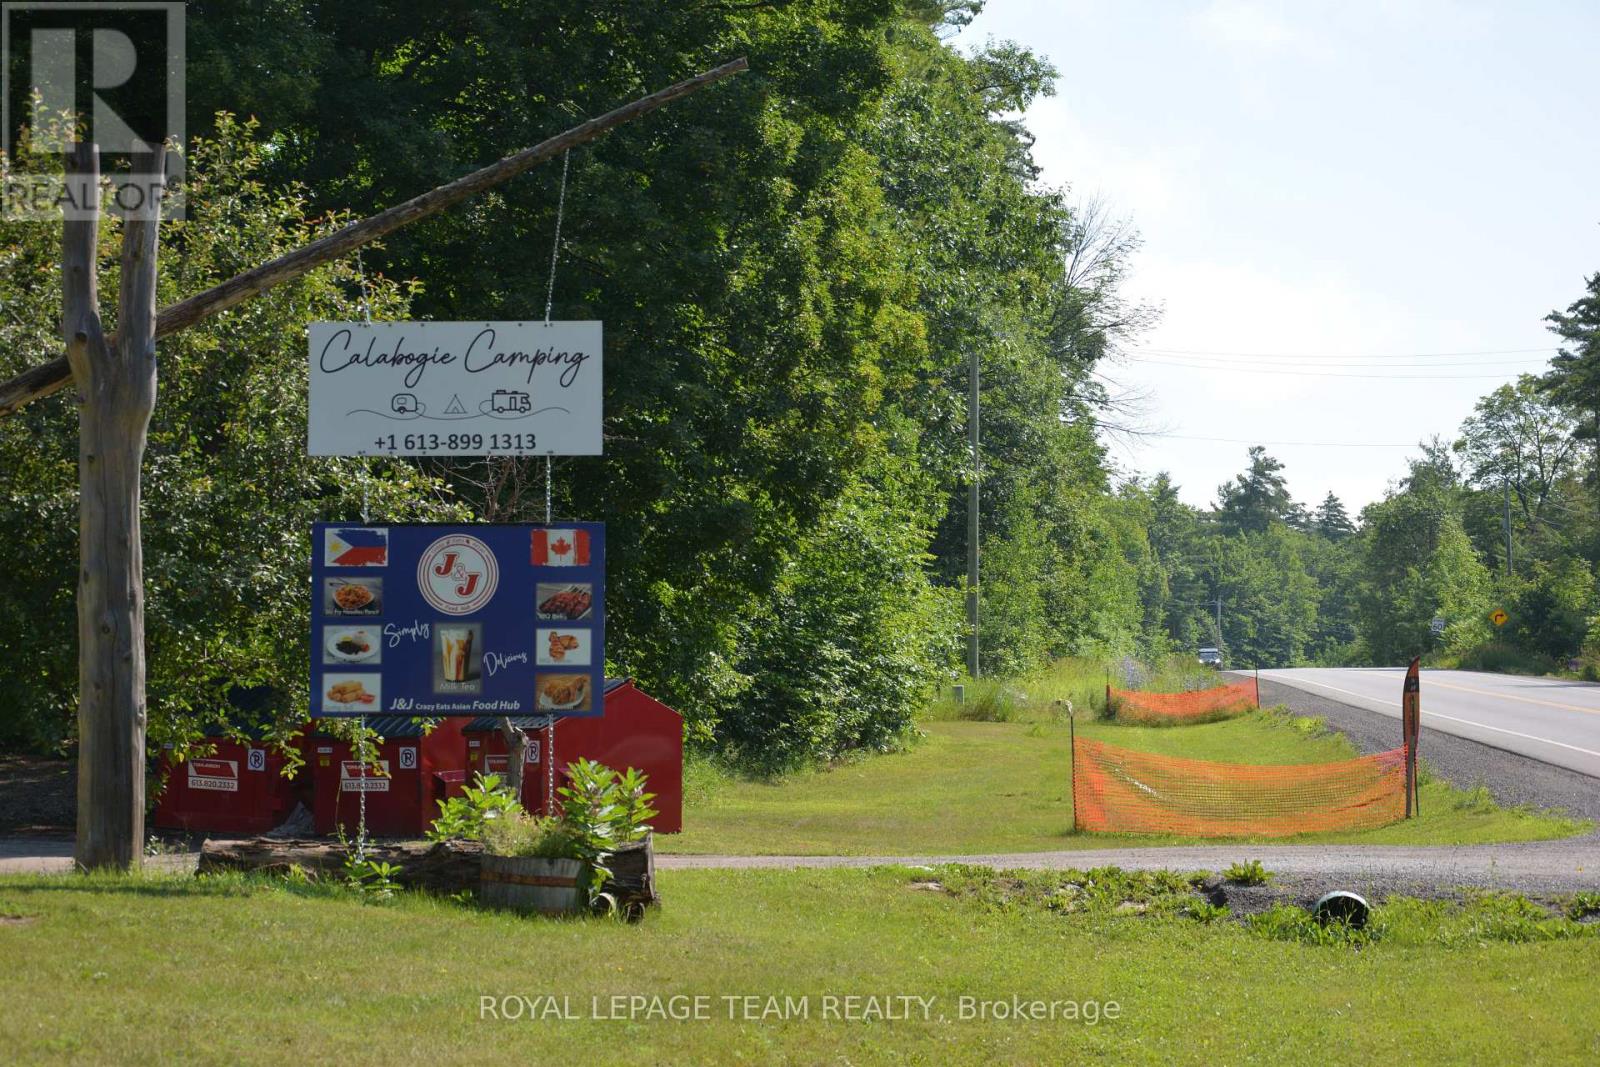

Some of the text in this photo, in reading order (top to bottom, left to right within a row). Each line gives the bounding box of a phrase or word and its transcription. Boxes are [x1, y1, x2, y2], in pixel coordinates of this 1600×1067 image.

[320, 328, 590, 388] Calabogie Camping
[375, 433, 536, 450] +1 613-899 1313
[383, 619, 430, 648] Simply
[389, 698, 414, 710] J&J
[415, 703, 435, 711] Crazy
[472, 700, 498, 710] Food
[499, 699, 520, 710] Hub
